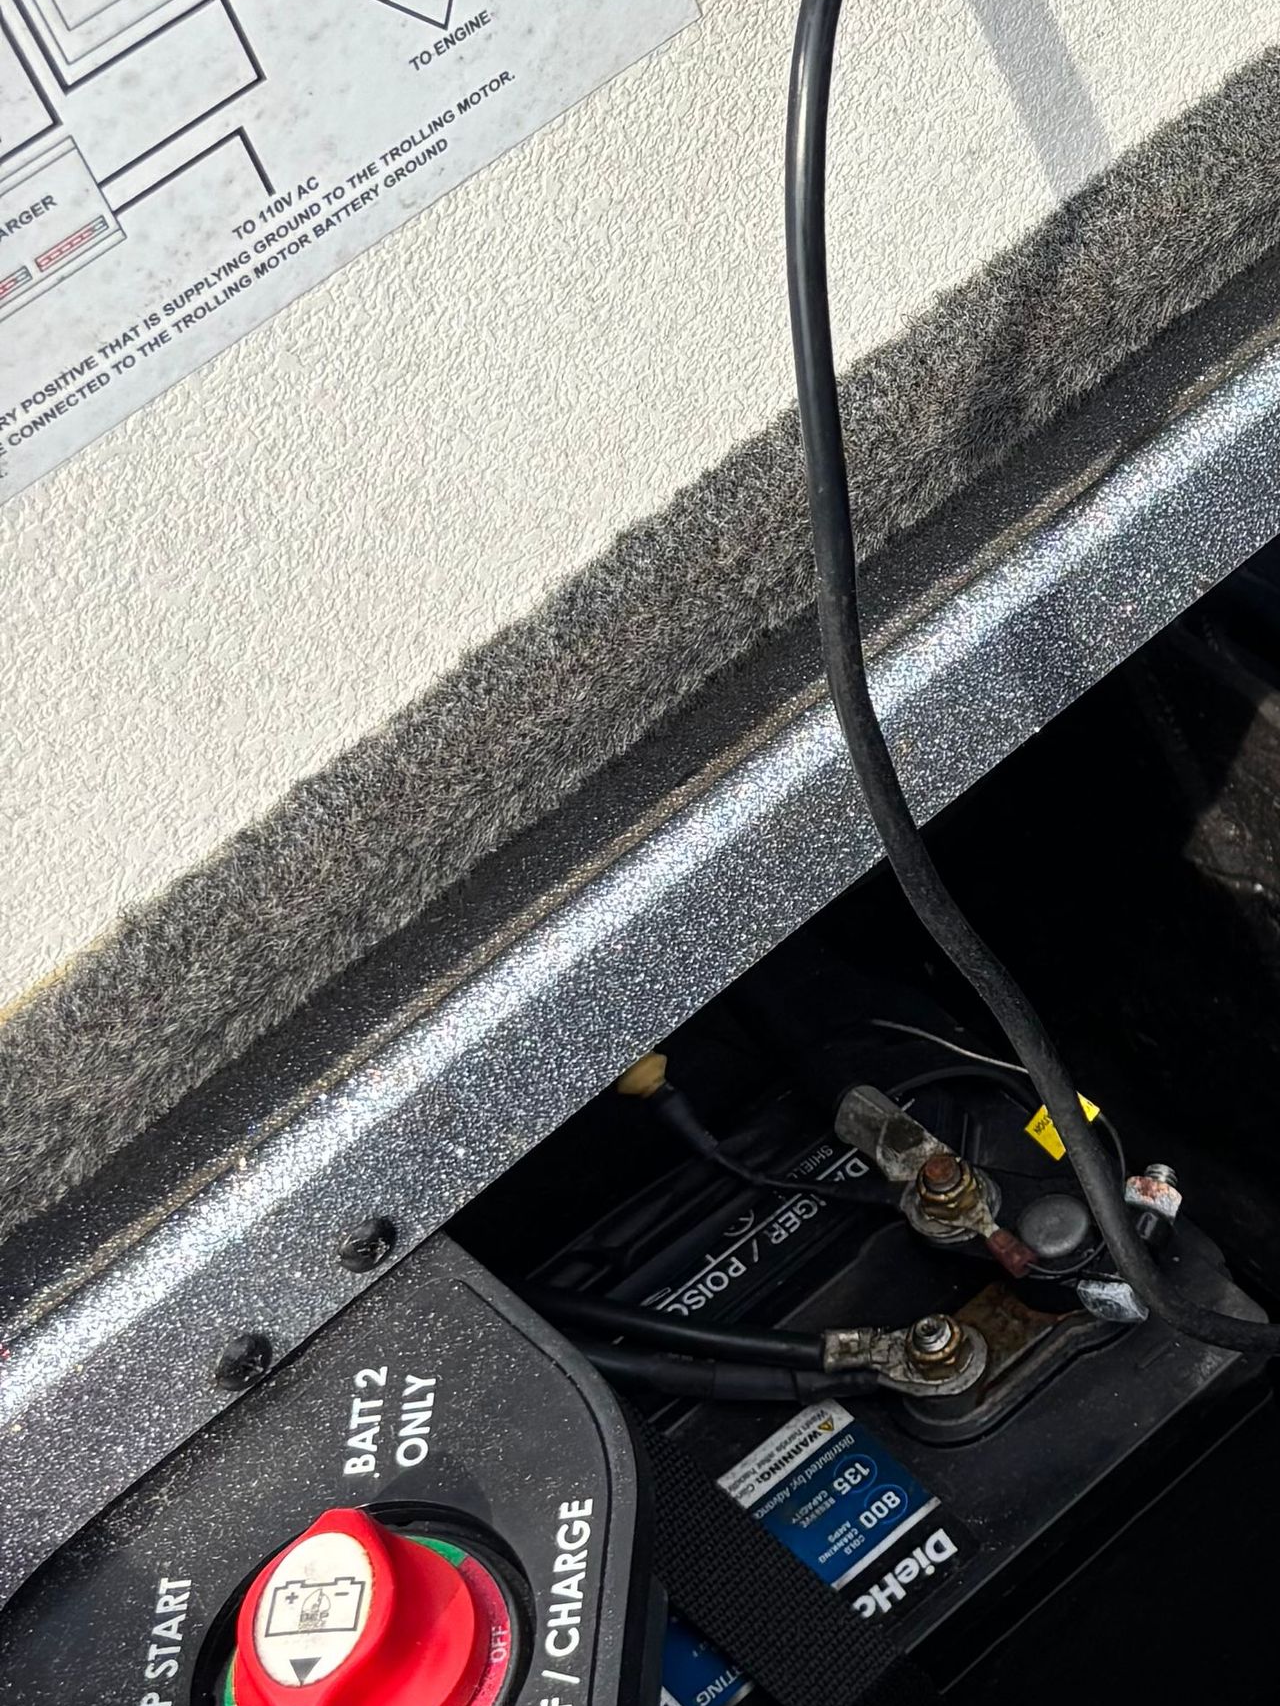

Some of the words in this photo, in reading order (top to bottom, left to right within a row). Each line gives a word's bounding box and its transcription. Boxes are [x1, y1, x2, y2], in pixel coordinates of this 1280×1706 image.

[408, 50, 432, 70] TO
[433, 10, 490, 55] ENGINE
[231, 218, 256, 239] TO
[258, 191, 292, 222] 110V
[296, 175, 319, 200] AC
[20, 355, 97, 413] POSITIVE
[97, 324, 140, 358] THAT
[142, 312, 161, 330] IS
[162, 250, 250, 316] SUPPLYING
[253, 202, 321, 253] GROUND
[321, 185, 345, 205] TO
[345, 161, 379, 188] THE
[379, 109, 455, 165] TROLLING
[456, 70, 515, 114] MOTOR.
[7, 372, 110, 446] CONNECTED
[110, 354, 135, 374] TO
[136, 329, 171, 357] THE
[172, 274, 251, 332] TROLLING
[253, 233, 311, 278] MOTOR
[312, 183, 378, 238] BATTERY
[383, 138, 447, 188] GROUND
[355, 1365, 388, 1389] 2
[344, 1399, 384, 1475] BATT
[395, 1373, 436, 1468] ONLY
[755, 1430, 821, 1483] WARNING:
[789, 1474, 807, 1490] by:
[804, 1433, 854, 1479] Distributed
[832, 1462, 869, 1494] 135
[859, 1491, 900, 1528] 800
[544, 1497, 594, 1657] CHARGE
[147, 1578, 192, 1683] START
[489, 1624, 507, 1664] OFF
[541, 1669, 580, 1687] /
[695, 1670, 736, 1706] TING
